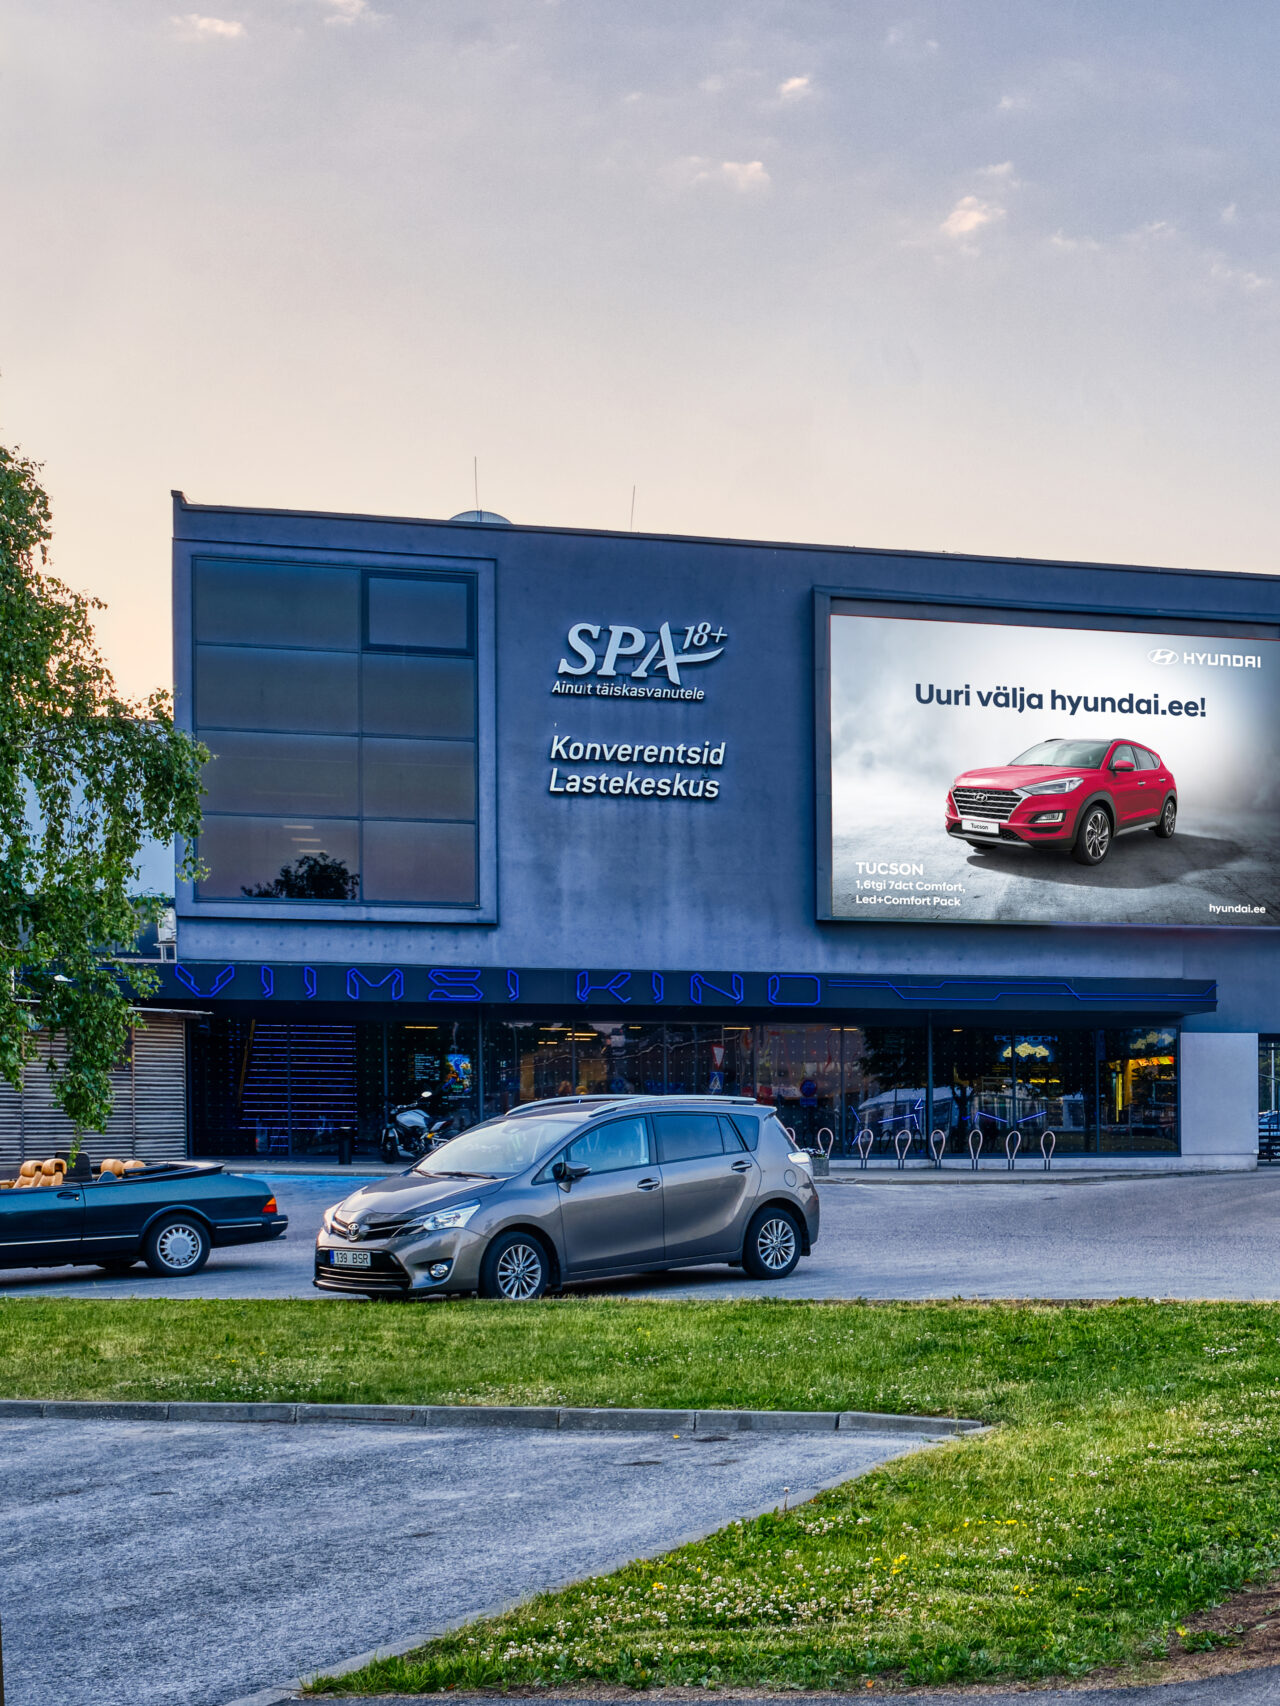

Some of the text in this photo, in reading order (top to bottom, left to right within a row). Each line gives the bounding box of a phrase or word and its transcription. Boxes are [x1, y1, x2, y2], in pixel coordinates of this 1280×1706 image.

[557, 621, 728, 685] SPA 18+
[1183, 652, 1261, 668] HYUNDAI
[596, 683, 705, 700] täiskasvanutele
[915, 683, 1207, 717] Uuri välja hyundai.ee!
[550, 735, 726, 765] Konverentsid
[549, 767, 720, 798] Lastekeskus
[971, 822, 989, 831] Tucson
[855, 862, 924, 876] TUCSON
[889, 881, 914, 890] 7dct
[915, 882, 966, 894] Comfort,
[855, 894, 961, 906] Led+Comfort Pack
[1209, 903, 1266, 914] hyundai.ee
[175, 964, 821, 1006] VIIMSI KINO
[336, 1252, 368, 1264] 139 BSR
